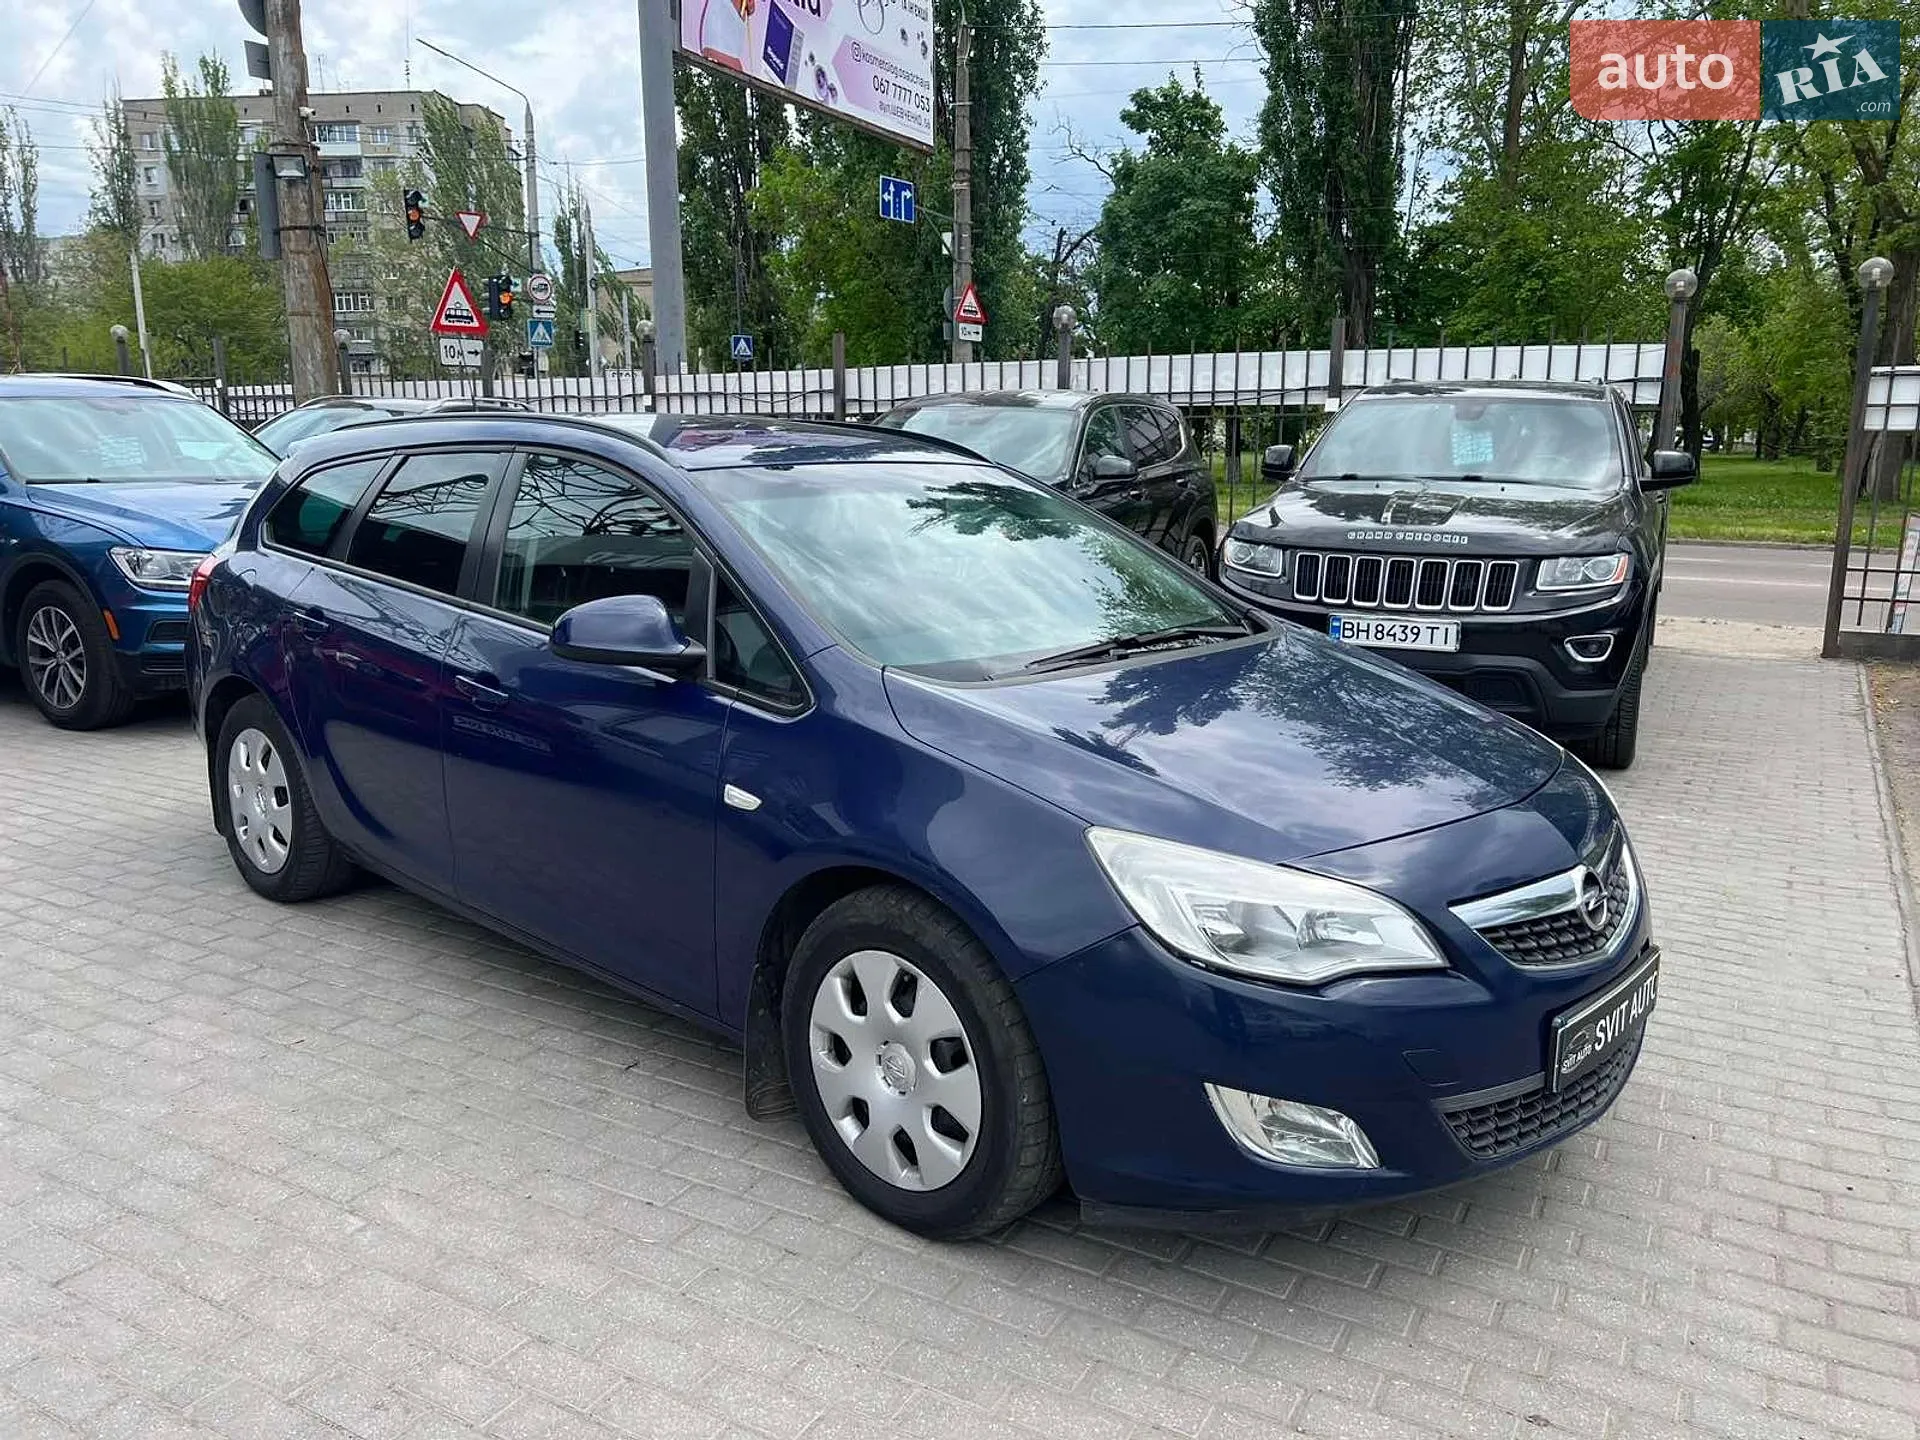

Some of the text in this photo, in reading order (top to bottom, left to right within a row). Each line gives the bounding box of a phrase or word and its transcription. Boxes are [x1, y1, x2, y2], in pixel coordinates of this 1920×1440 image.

[872, 75, 930, 113] 067 7777 053
[1347, 530, 1393, 540] GRAND
[1594, 999, 1629, 1052] SVIT
